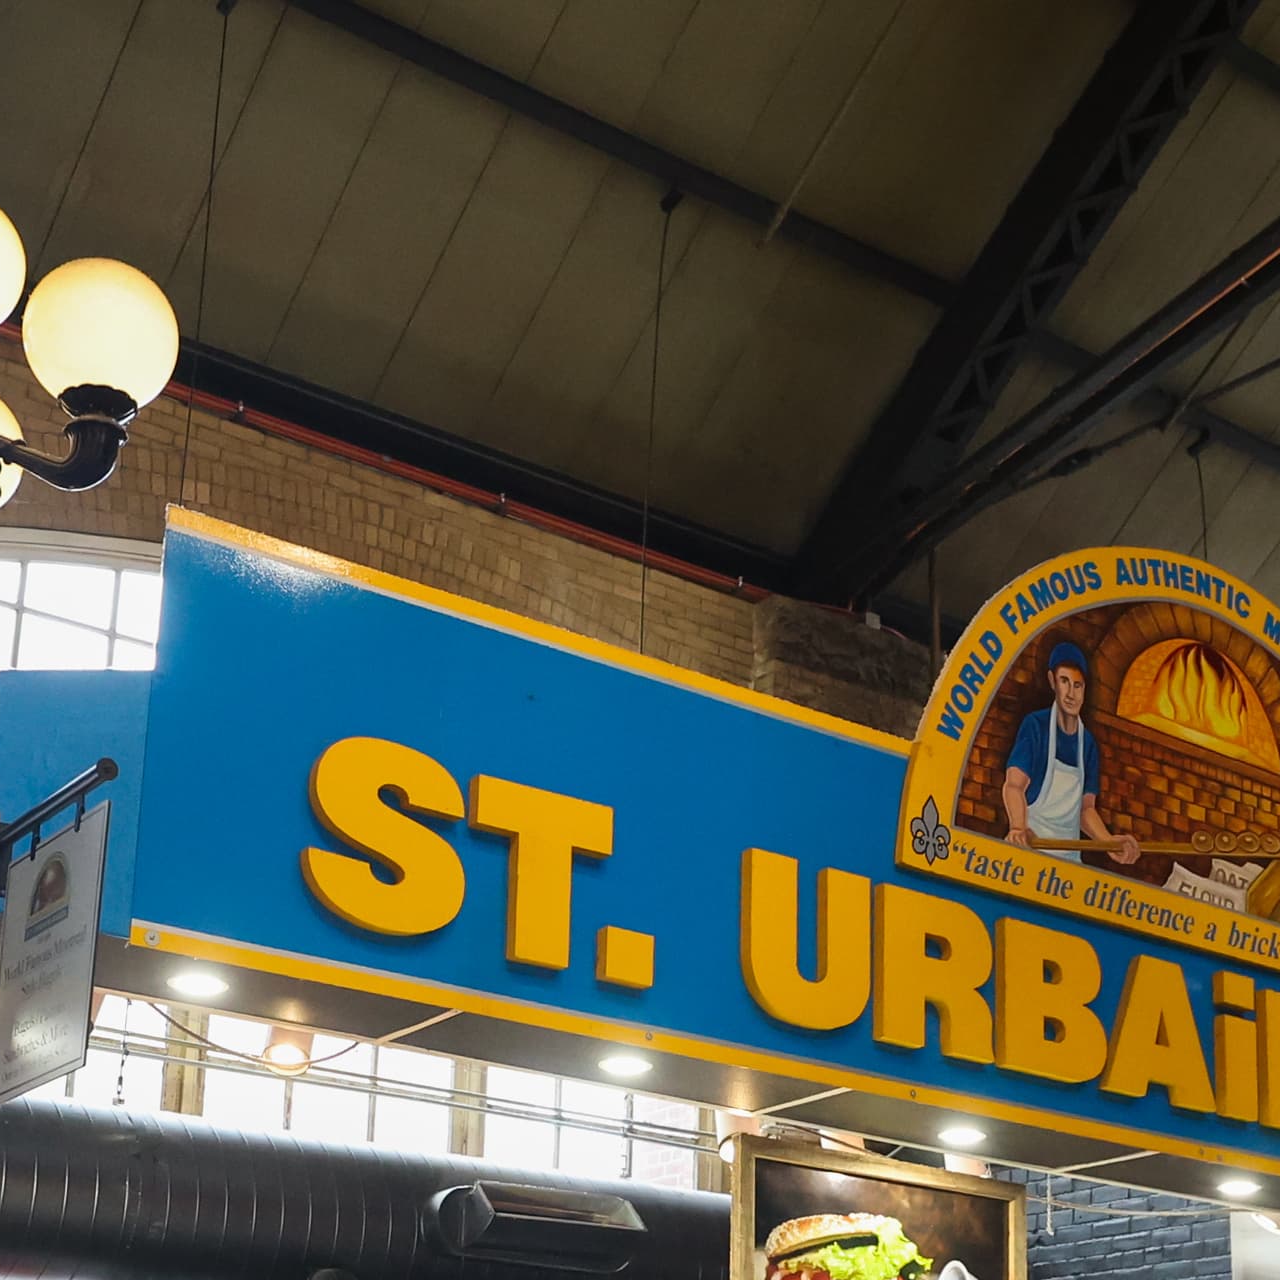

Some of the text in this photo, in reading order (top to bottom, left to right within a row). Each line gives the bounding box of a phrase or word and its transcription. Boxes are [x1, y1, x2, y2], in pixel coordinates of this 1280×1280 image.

[936, 631, 1003, 742] WORLD
[999, 560, 1103, 637] FAMOUS
[1115, 556, 1253, 620] AUTHENTIC
[300, 735, 655, 990] ST.
[1035, 866, 1075, 902] the
[1083, 878, 1196, 937] difference
[1206, 922, 1217, 940] a
